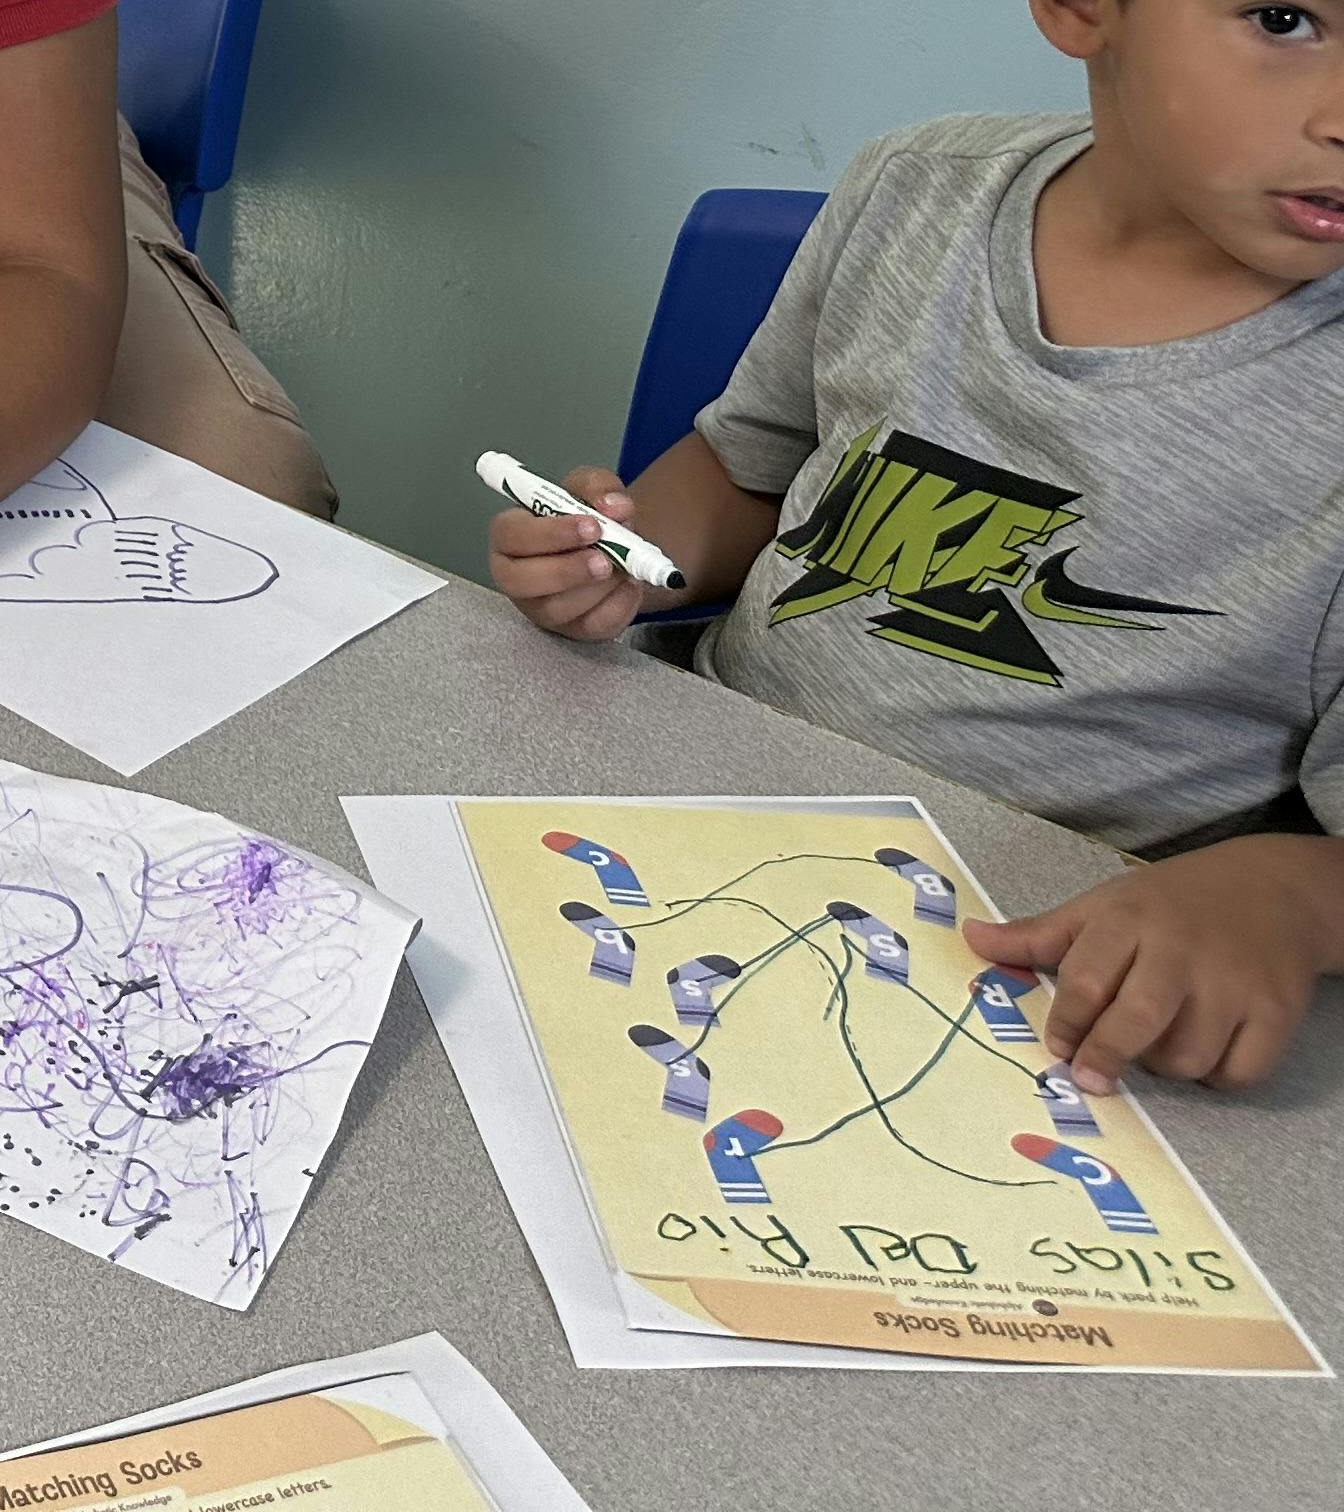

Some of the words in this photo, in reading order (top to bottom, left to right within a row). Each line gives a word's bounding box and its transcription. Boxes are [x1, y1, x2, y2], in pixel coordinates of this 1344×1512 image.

[774, 418, 1086, 630] NIKE
[913, 873, 948, 897] B
[973, 982, 1013, 1008] R
[657, 1212, 810, 1268] Rio
[839, 1224, 978, 1275] Del
[746, 1263, 803, 1280] letters.
[1029, 1237, 1236, 1291] Silas
[808, 1270, 884, 1286] lowercase
[891, 1275, 917, 1287] and
[985, 1279, 1011, 1292] the
[1014, 1280, 1089, 1298] matching
[1094, 1286, 1113, 1300] by
[1119, 1289, 1156, 1304] pack
[1161, 1292, 1200, 1308] Help
[874, 1311, 961, 1338] Socks
[966, 1313, 1113, 1347] Matching
[119, 1448, 204, 1486] Socks
[195, 1488, 276, 1512] lowercase
[276, 1477, 332, 1501] letters.
